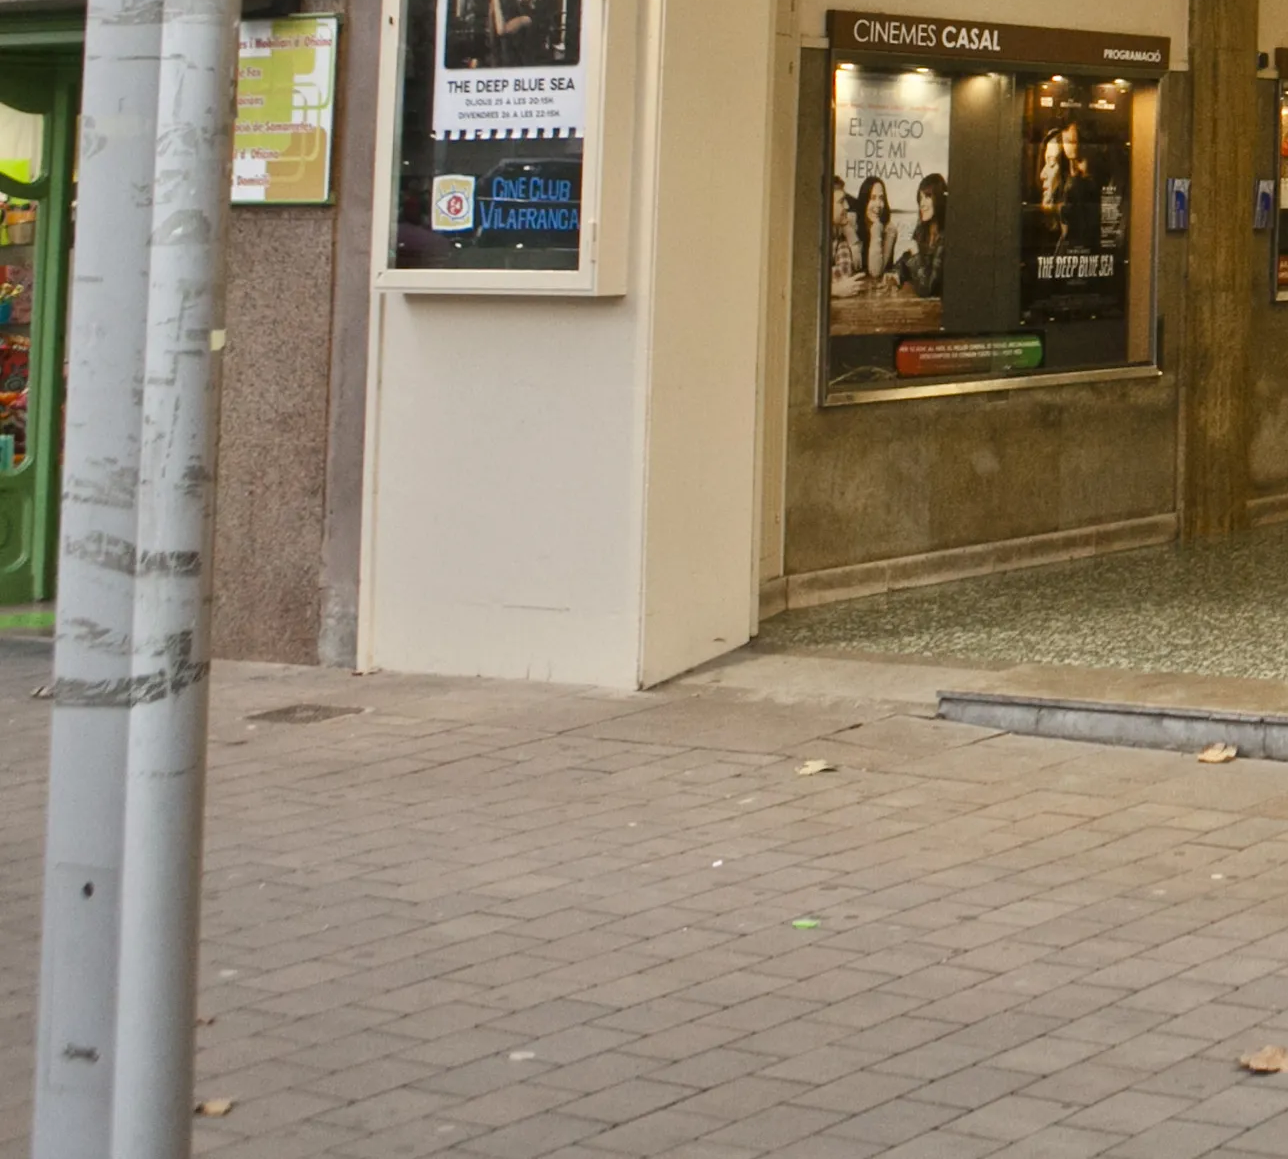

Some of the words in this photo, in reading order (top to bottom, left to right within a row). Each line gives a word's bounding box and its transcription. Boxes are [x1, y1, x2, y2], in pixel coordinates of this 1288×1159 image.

[853, 19, 937, 47] CINEMES
[942, 25, 1000, 52] CASAL
[1103, 48, 1162, 63] PROGRAMACIÓ
[447, 81, 471, 93] THE
[476, 79, 509, 93] DEEP
[514, 78, 545, 91] BLUE
[550, 77, 575, 90] SEA
[849, 118, 863, 137] EL
[868, 119, 924, 139] AMIGO
[865, 140, 885, 158] DE
[888, 141, 906, 159] MI
[846, 160, 924, 180] HERMANA
[529, 177, 572, 202] CLUB
[1038, 256, 1053, 279] THE
[1055, 256, 1077, 278] DEEP
[1078, 254, 1098, 278] BLUE
[1099, 254, 1114, 277] SEA
